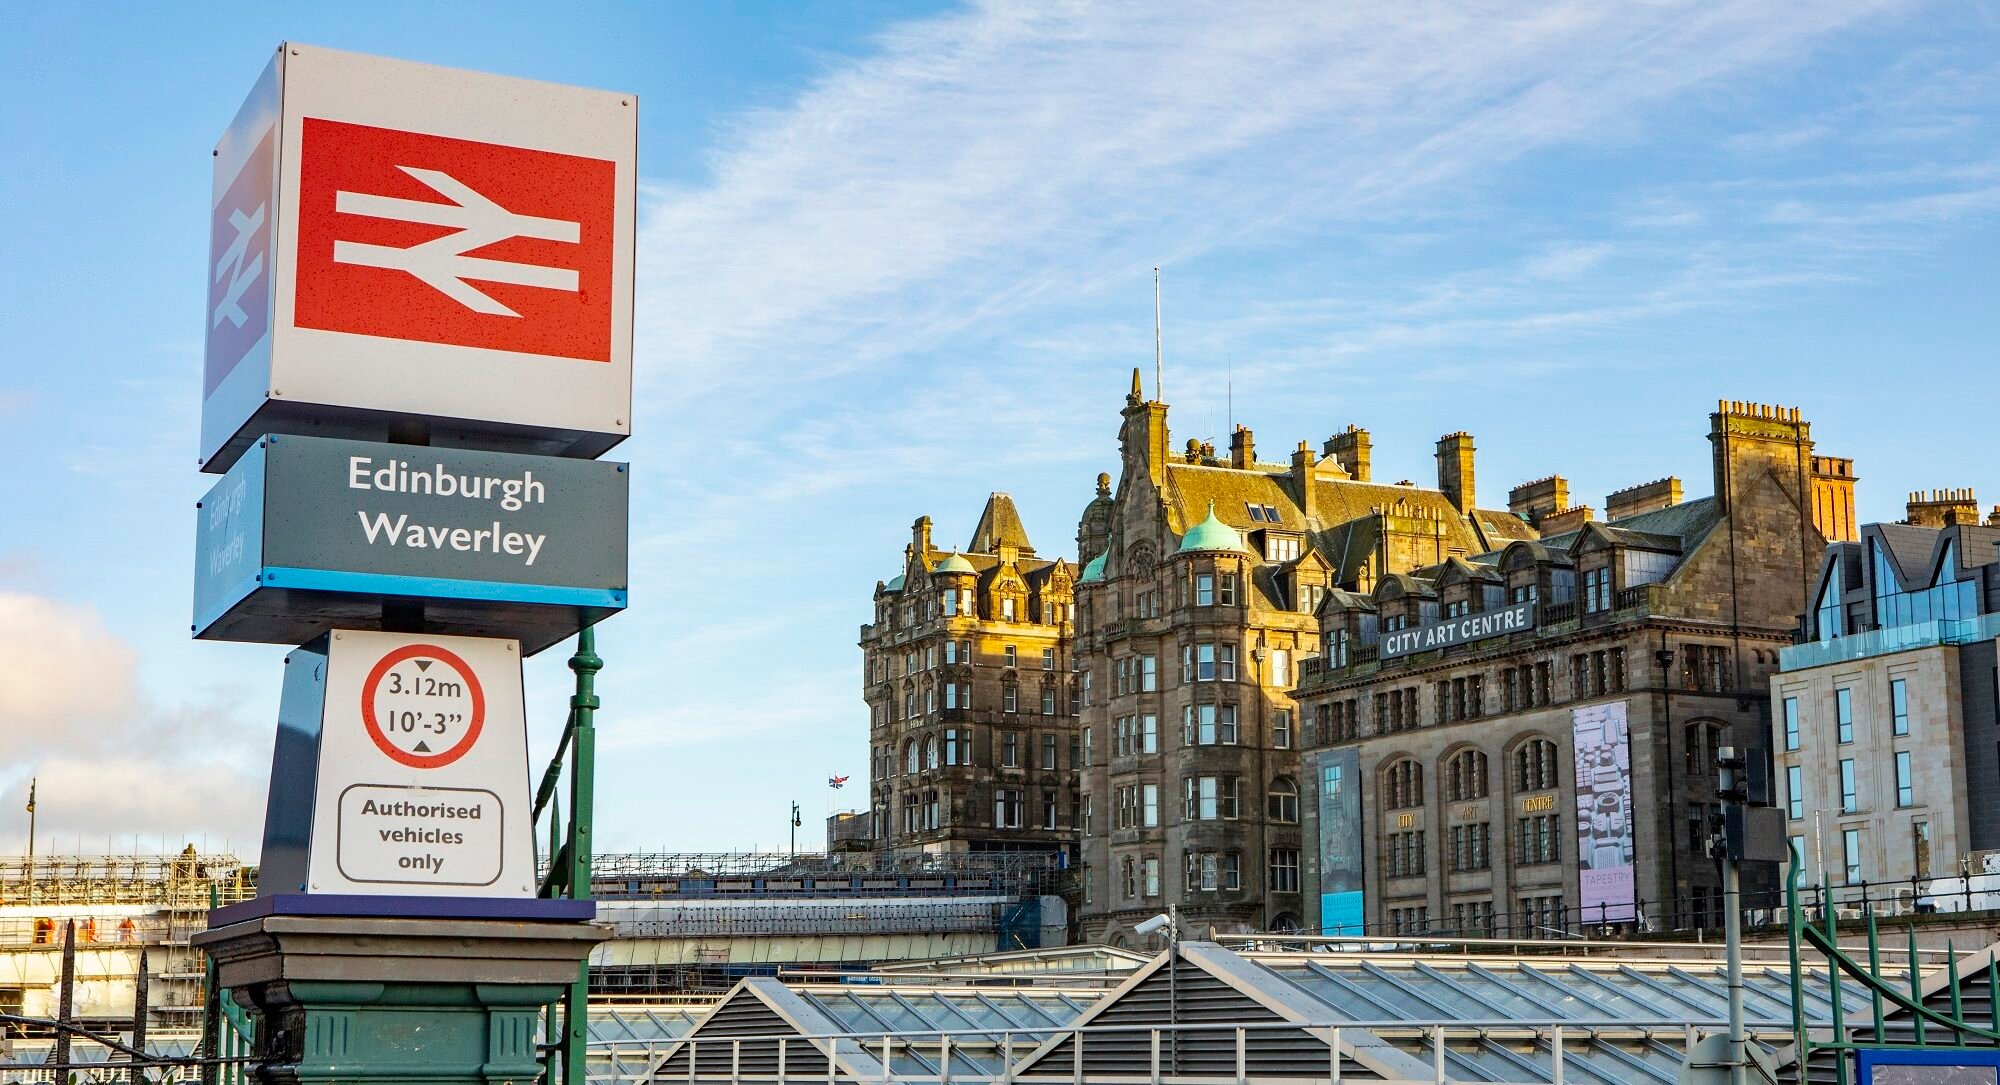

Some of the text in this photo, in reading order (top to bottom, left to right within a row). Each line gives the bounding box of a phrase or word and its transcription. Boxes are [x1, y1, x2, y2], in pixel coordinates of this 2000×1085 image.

[349, 456, 545, 511] Edinburgh
[209, 471, 247, 532] Edinburgh
[209, 530, 245, 578] Waverley
[358, 511, 546, 566] Waverley
[1386, 607, 1525, 654] CITY ART CENTRE
[389, 672, 461, 698] 3.12m
[361, 799, 481, 819] Authorised
[1397, 795, 1553, 828] CITY ART CENTRE
[379, 827, 463, 845] vehicles
[398, 853, 445, 875] only
[1583, 871, 1630, 886] TAPESTRY
